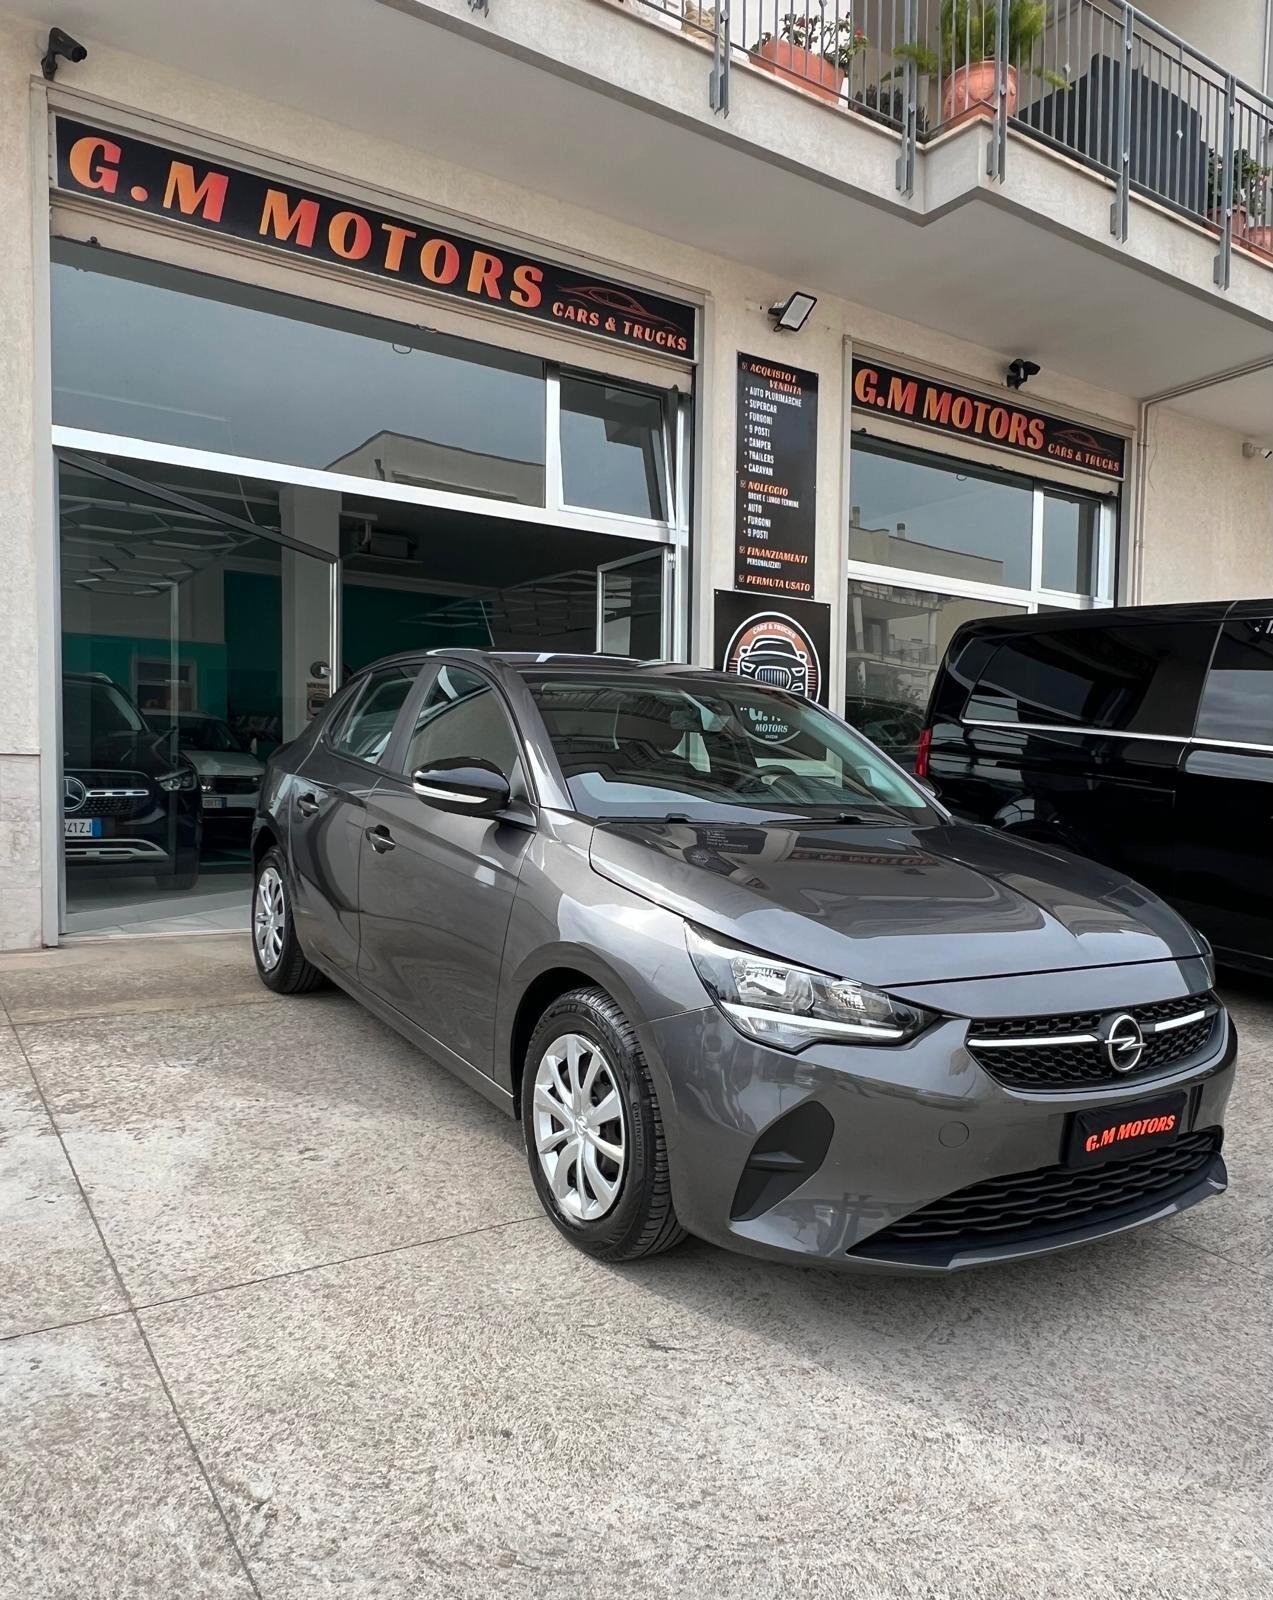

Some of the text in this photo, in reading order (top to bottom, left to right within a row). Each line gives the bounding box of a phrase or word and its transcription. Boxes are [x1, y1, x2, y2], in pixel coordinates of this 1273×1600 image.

[69, 136, 544, 308] G.M MOTORS
[552, 302, 687, 351] CARS & TRUCKS
[750, 363, 791, 381] ACQUISTO
[769, 379, 802, 395] VENDITA
[749, 386, 802, 408] AUTO PLURIMARCHE
[749, 399, 777, 413] SUPERCAR
[854, 368, 1044, 450] G.M MOTORS
[749, 411, 773, 425] FURGONI
[754, 425, 770, 437] POSTI
[748, 437, 772, 451] CAMPER
[749, 450, 774, 464] TRAILERS
[1048, 443, 1120, 472] CARS & TRUCKS
[748, 463, 773, 476] CARAVAN
[747, 481, 789, 496] NOLEGGIO
[748, 503, 762, 514] AUTO
[748, 515, 771, 528] FURGONI
[752, 529, 768, 540] POSTI
[747, 546, 808, 564] FINANZIAMENTI
[746, 575, 810, 592] PERMUTA USATO
[755, 723, 788, 733] MOTORS
[1085, 1114, 1176, 1152] G.M MOTORS
